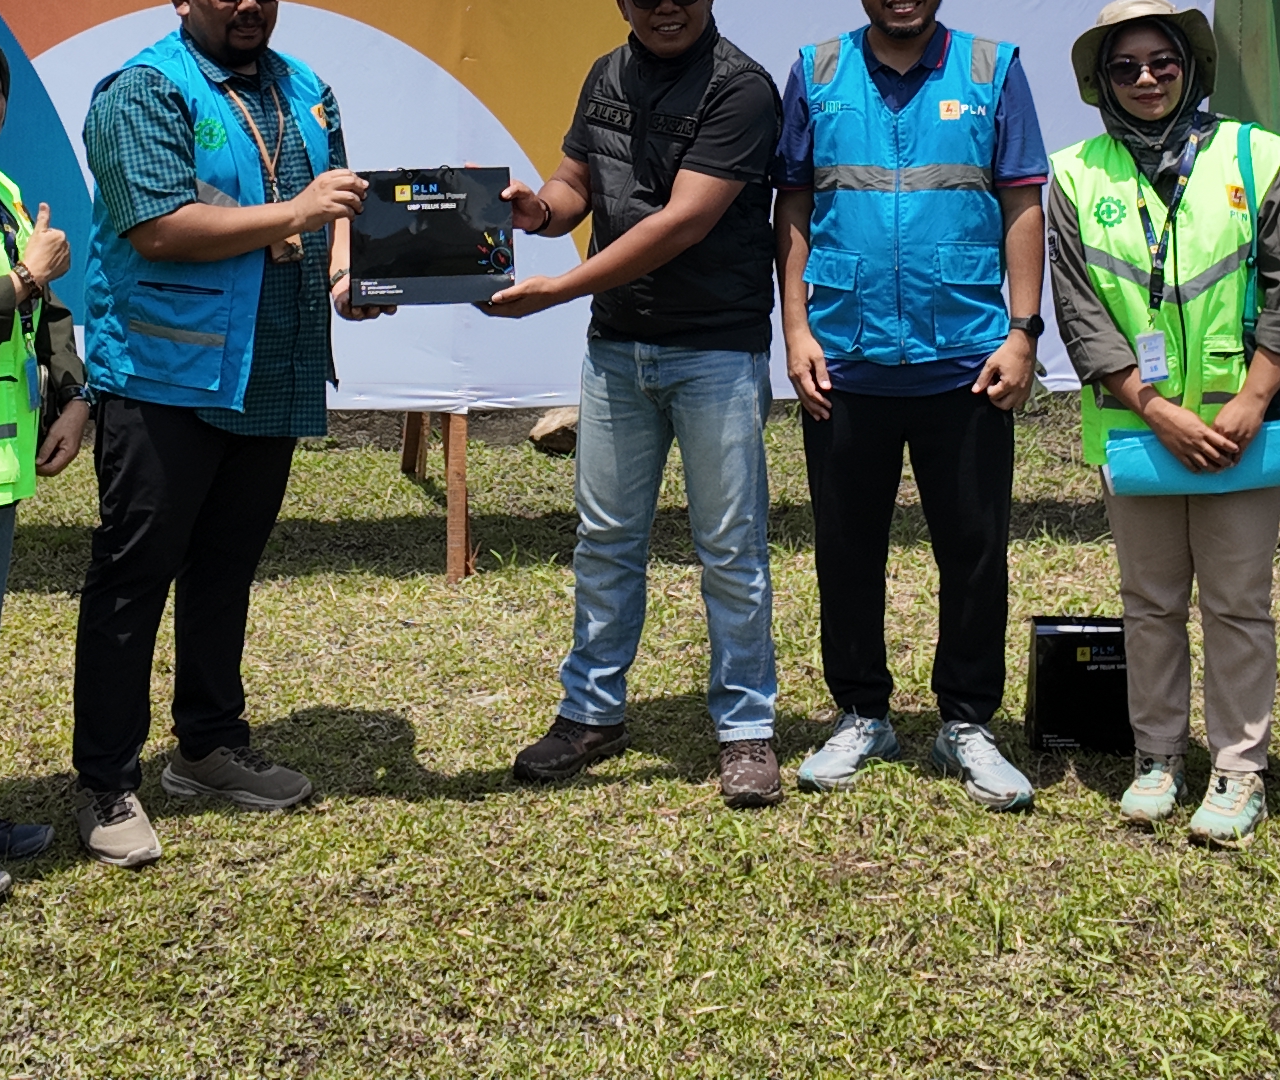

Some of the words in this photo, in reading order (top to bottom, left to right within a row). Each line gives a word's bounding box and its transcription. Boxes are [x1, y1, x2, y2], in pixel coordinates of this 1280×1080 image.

[590, 102, 629, 126] ALEX
[960, 104, 986, 116] PLN
[412, 183, 437, 193] PLN
